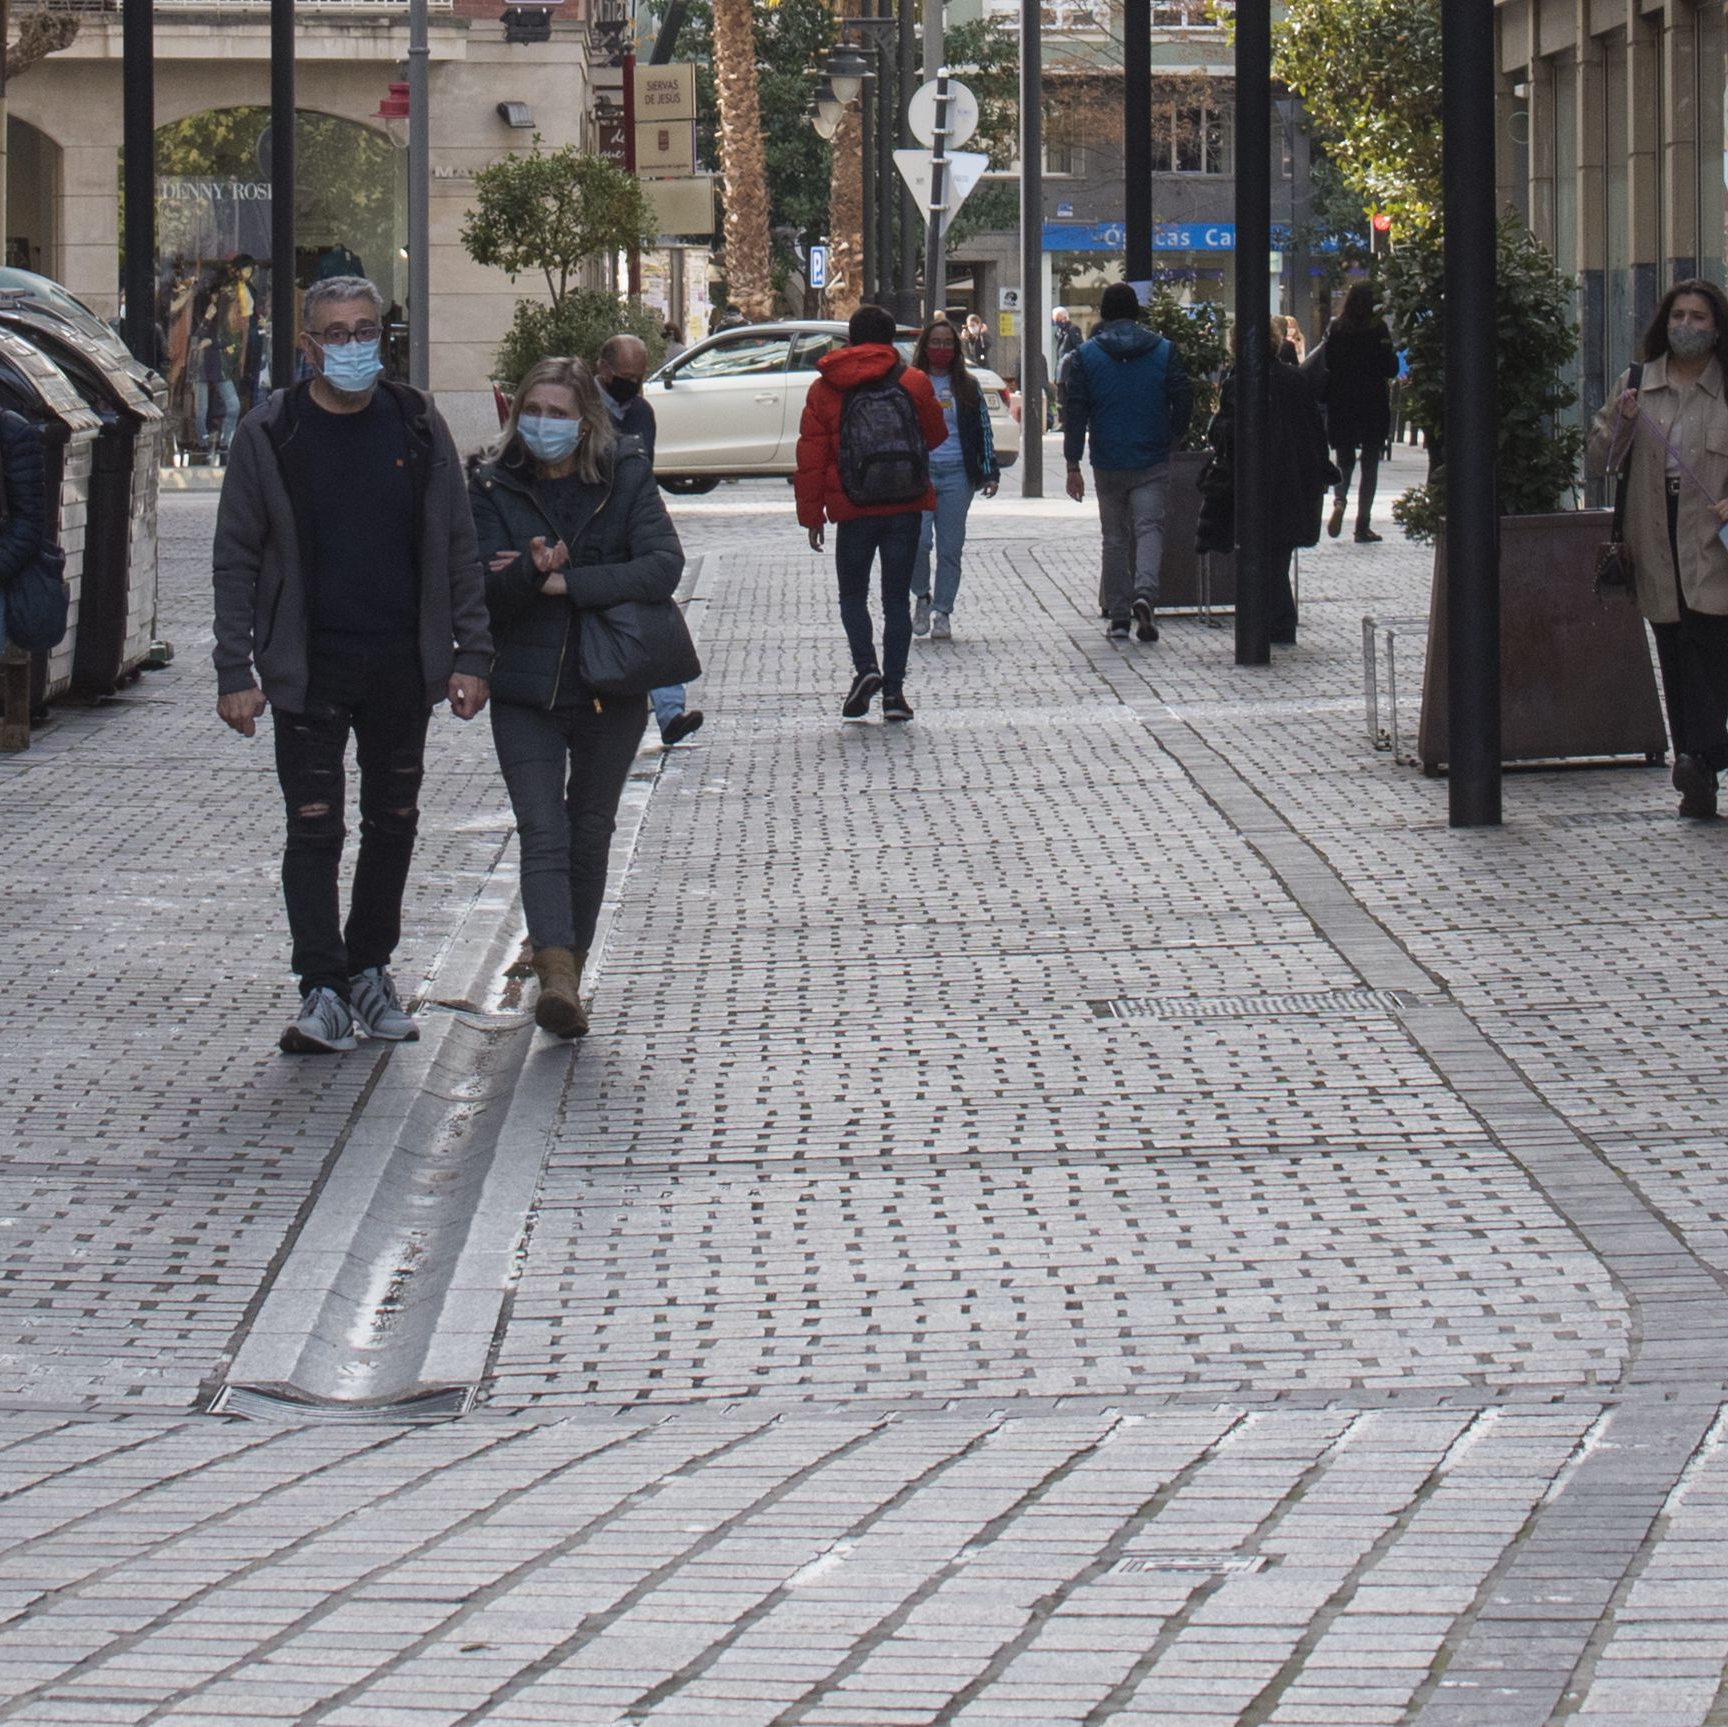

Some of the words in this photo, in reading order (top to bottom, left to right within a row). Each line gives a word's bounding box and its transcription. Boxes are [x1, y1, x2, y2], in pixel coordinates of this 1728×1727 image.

[646, 79, 679, 92] SIERVAS
[644, 94, 655, 105] DE
[161, 182, 225, 200] DENNY
